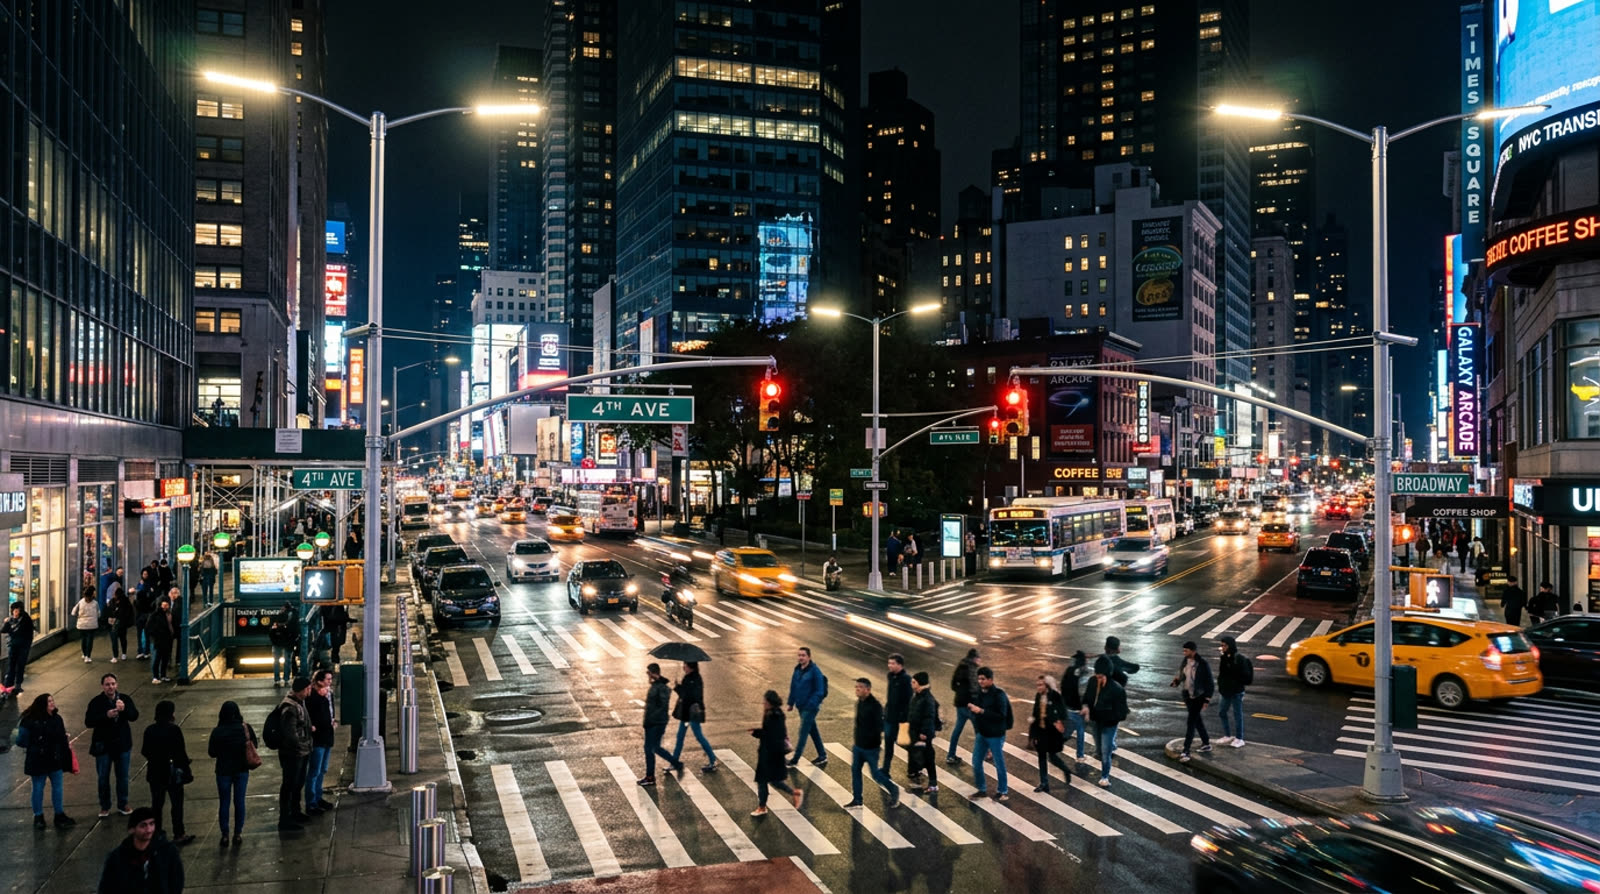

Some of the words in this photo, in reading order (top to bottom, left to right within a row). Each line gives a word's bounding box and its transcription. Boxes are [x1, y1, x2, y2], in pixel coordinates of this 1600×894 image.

[1465, 24, 1481, 104] TIMES
[1519, 129, 1541, 153] NYC
[1466, 126, 1481, 224] SQUARE
[1510, 221, 1569, 255] COFFEE
[1458, 326, 1473, 386] GALAXY
[592, 401, 622, 416] 4TH
[630, 402, 670, 417] AVE
[1458, 391, 1474, 450] ARCADE
[301, 472, 324, 487] 4TH
[329, 472, 355, 487] AVE
[1054, 468, 1099, 478] COFFEE
[1397, 477, 1463, 492] BROADWAY
[1433, 508, 1469, 516] COFFEE
